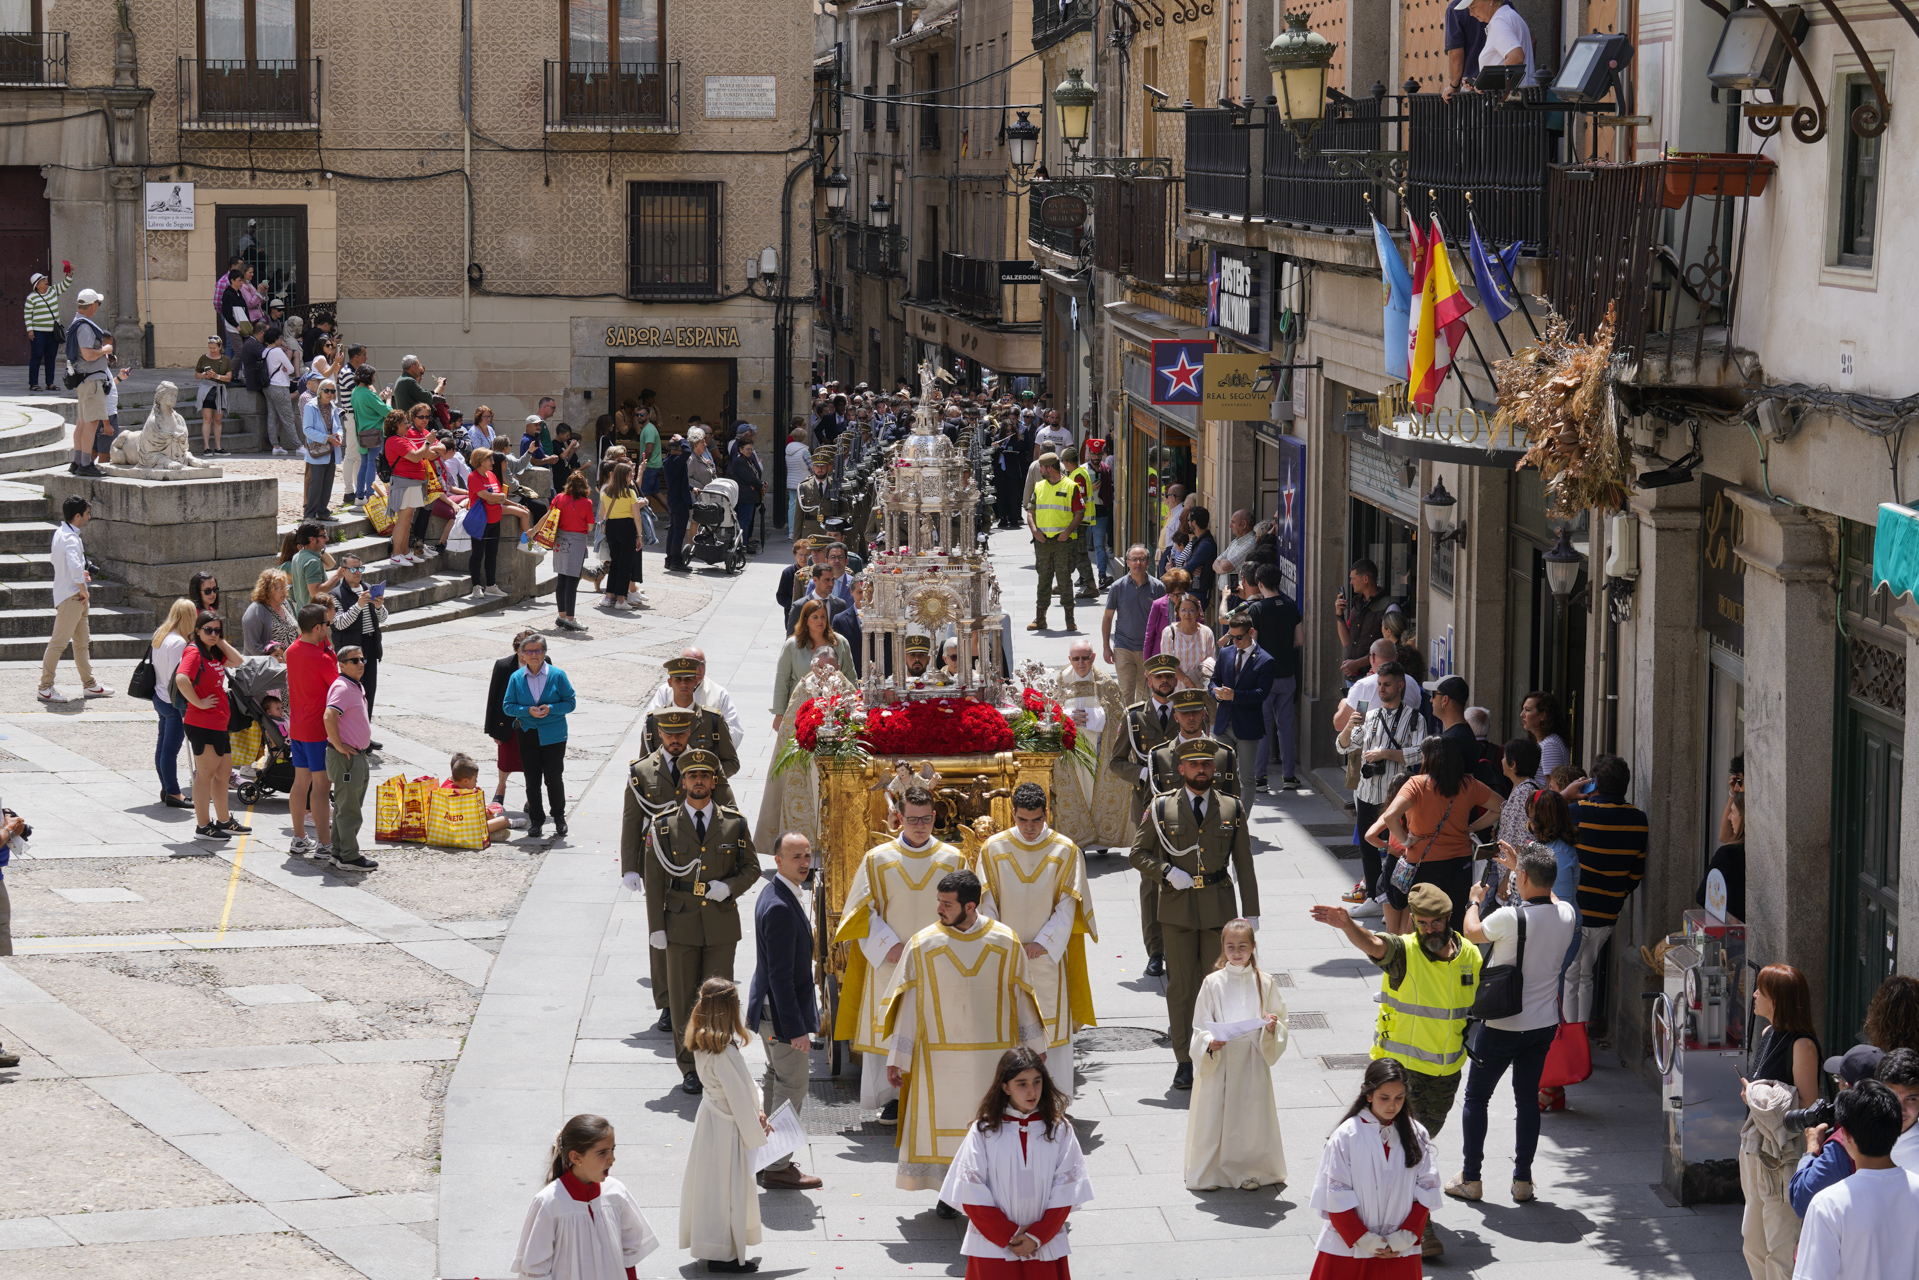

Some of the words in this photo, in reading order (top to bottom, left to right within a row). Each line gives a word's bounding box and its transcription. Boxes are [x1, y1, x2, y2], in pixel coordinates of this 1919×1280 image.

[1221, 256, 1251, 298] FOSTER'S
[1219, 291, 1250, 335] HOLLYWOOD
[606, 326, 661, 347] SABOR
[662, 328, 674, 345] A
[676, 326, 741, 347] ESPAÑA
[444, 811, 464, 822] ANETO
